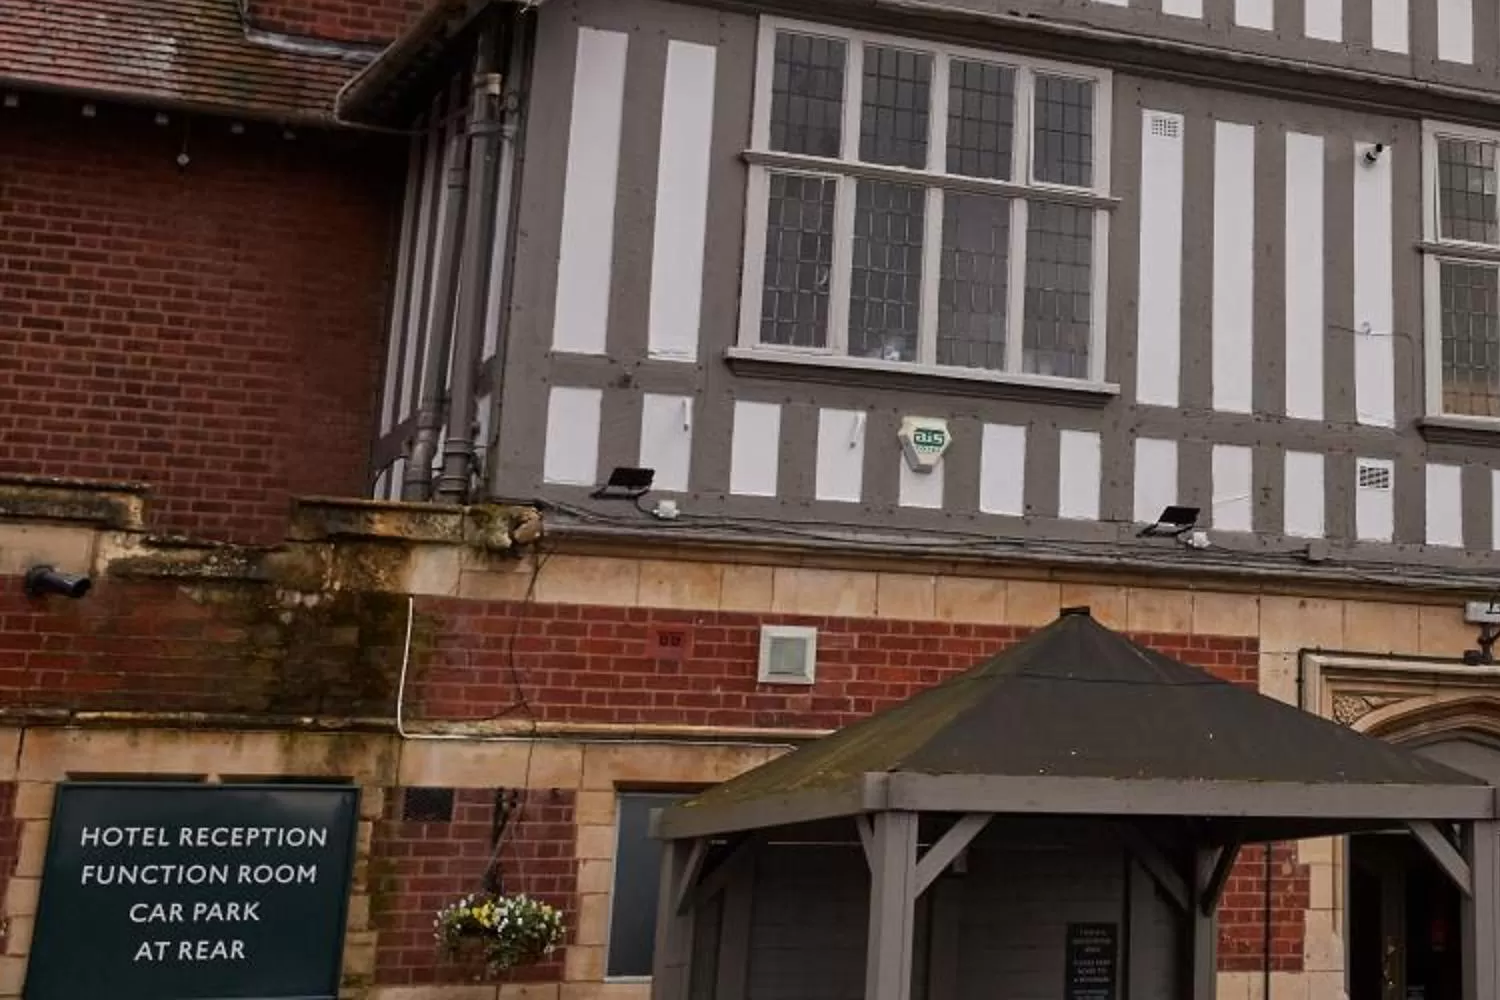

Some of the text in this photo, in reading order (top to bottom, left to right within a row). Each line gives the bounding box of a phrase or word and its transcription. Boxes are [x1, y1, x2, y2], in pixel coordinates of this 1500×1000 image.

[80, 826, 327, 847] HOTEL RECEPTION
[81, 864, 317, 885] FUNCTION ROOM
[129, 902, 260, 923] CAR PARK
[133, 940, 245, 961] AT REAR
